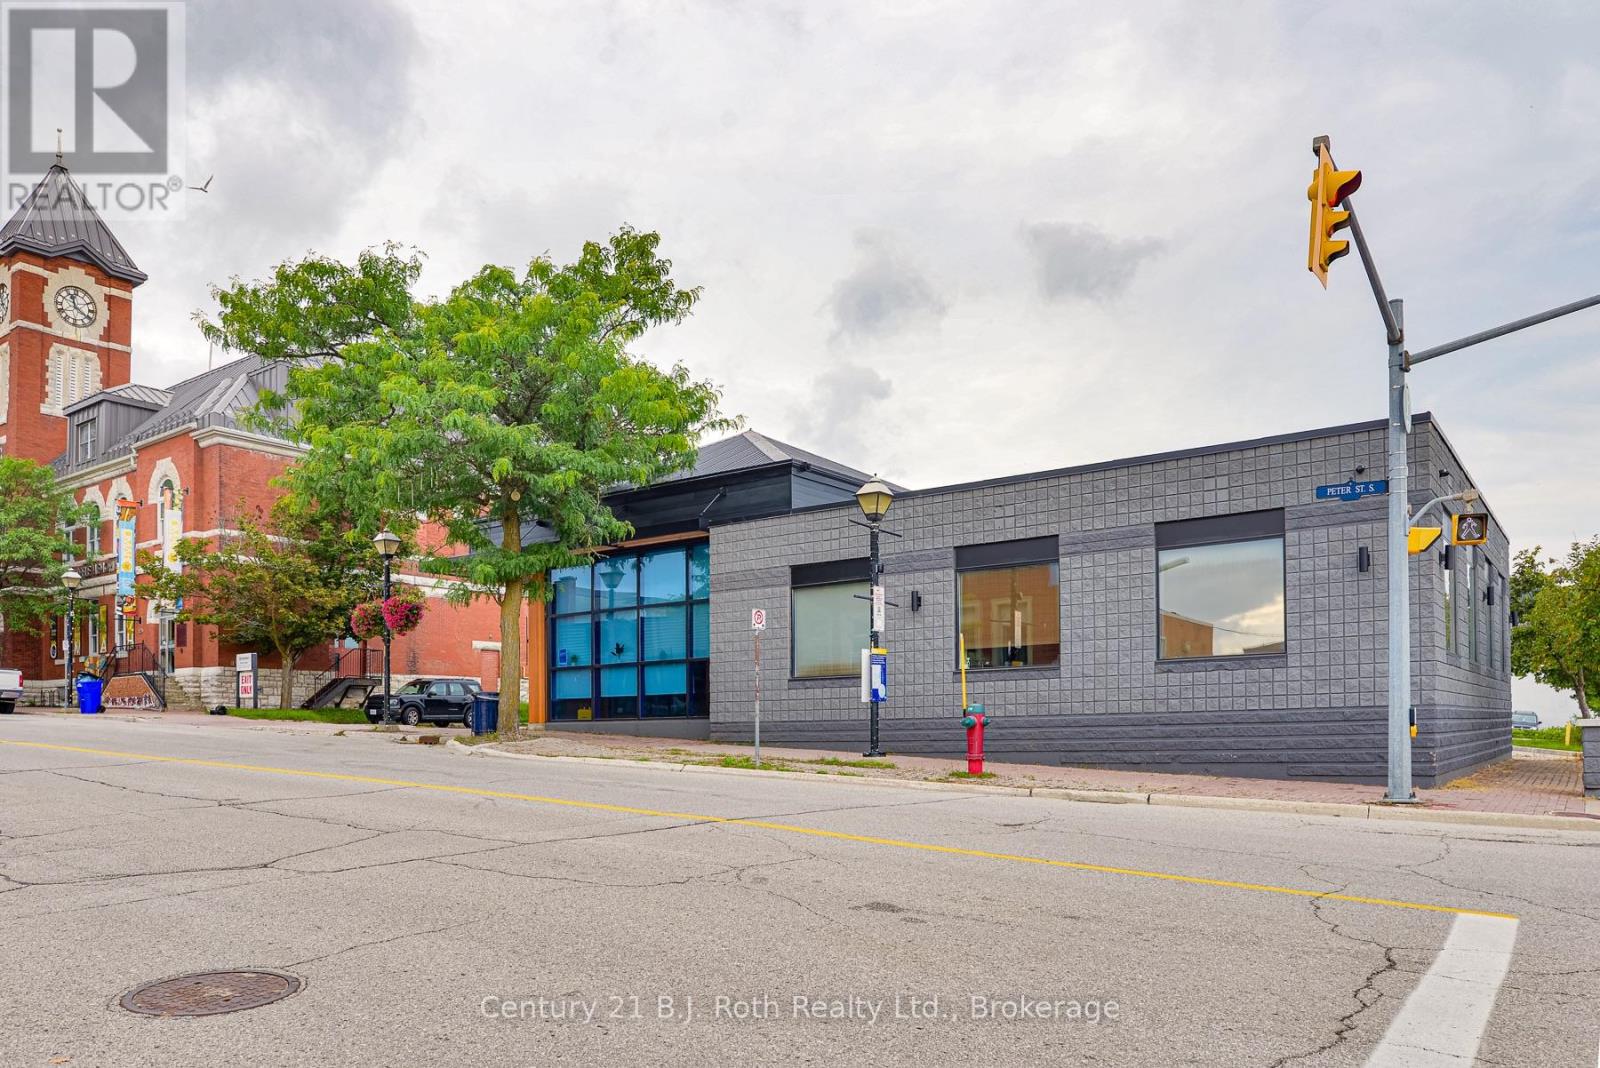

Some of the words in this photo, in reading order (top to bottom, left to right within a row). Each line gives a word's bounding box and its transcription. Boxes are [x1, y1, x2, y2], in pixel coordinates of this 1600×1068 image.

[1327, 486, 1351, 496] PETER
[1355, 484, 1366, 492] ST.
[241, 675, 252, 684] EXIT
[241, 685, 252, 695] ONLY
